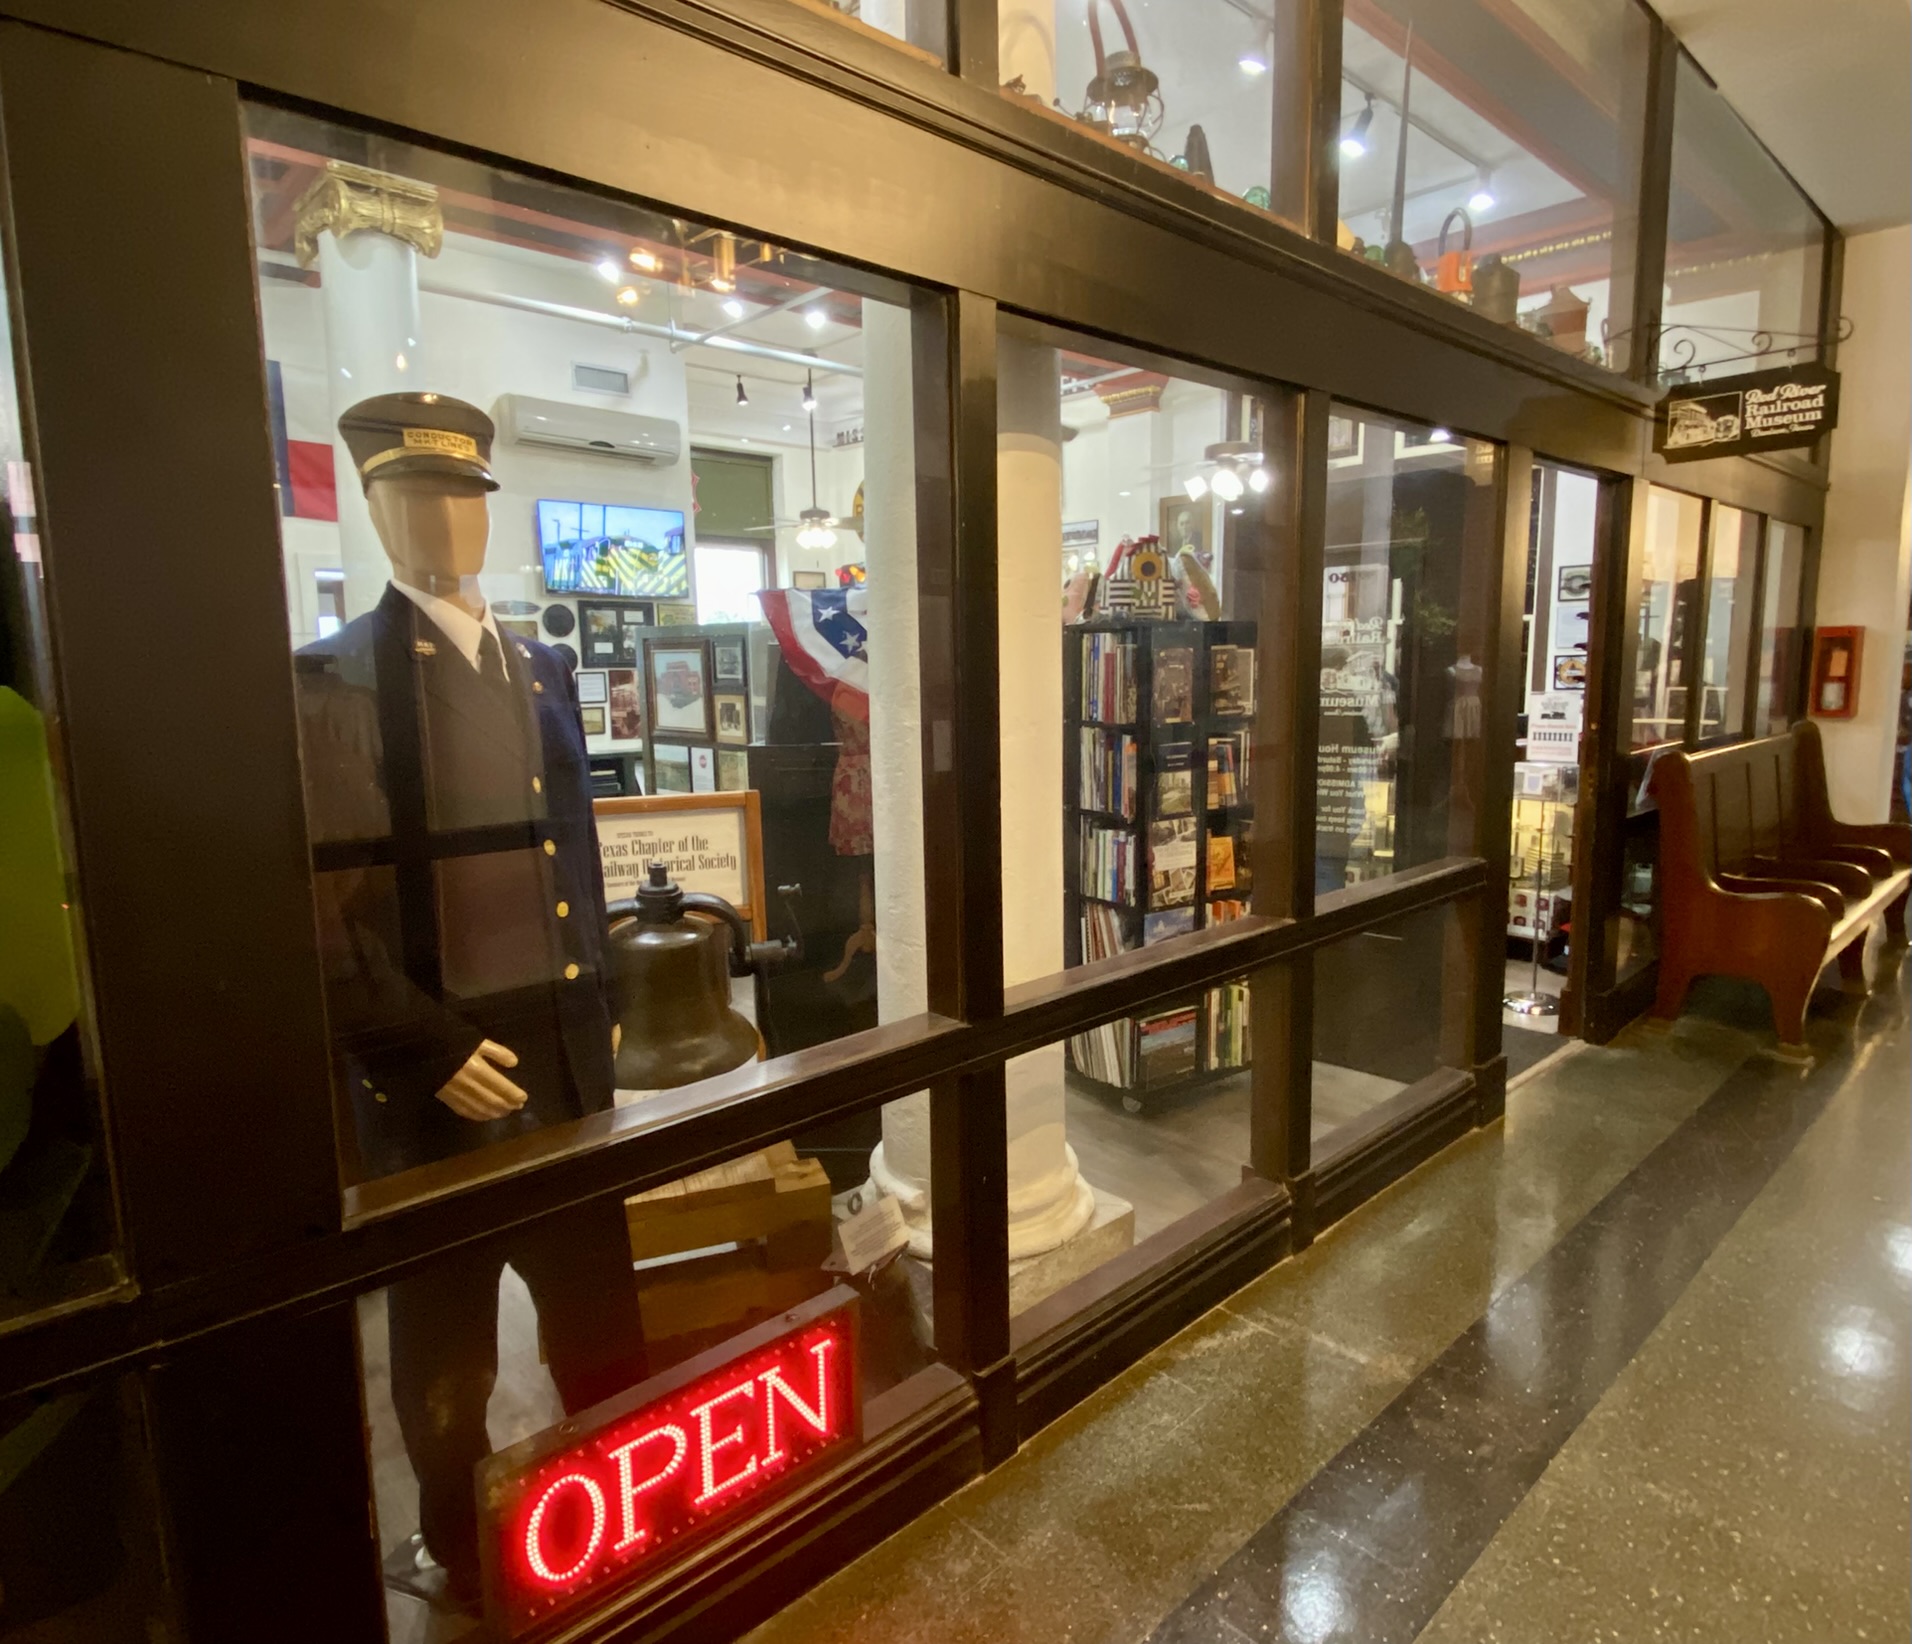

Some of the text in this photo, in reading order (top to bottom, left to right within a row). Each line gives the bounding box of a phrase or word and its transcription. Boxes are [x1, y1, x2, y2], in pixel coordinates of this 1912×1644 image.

[1745, 394, 1824, 418] Railroad
[1744, 410, 1823, 430] Museum
[600, 835, 709, 859] exas Chapter of the
[603, 859, 640, 879] ailway
[698, 852, 737, 871] Society
[526, 1339, 833, 1583] OPEN
